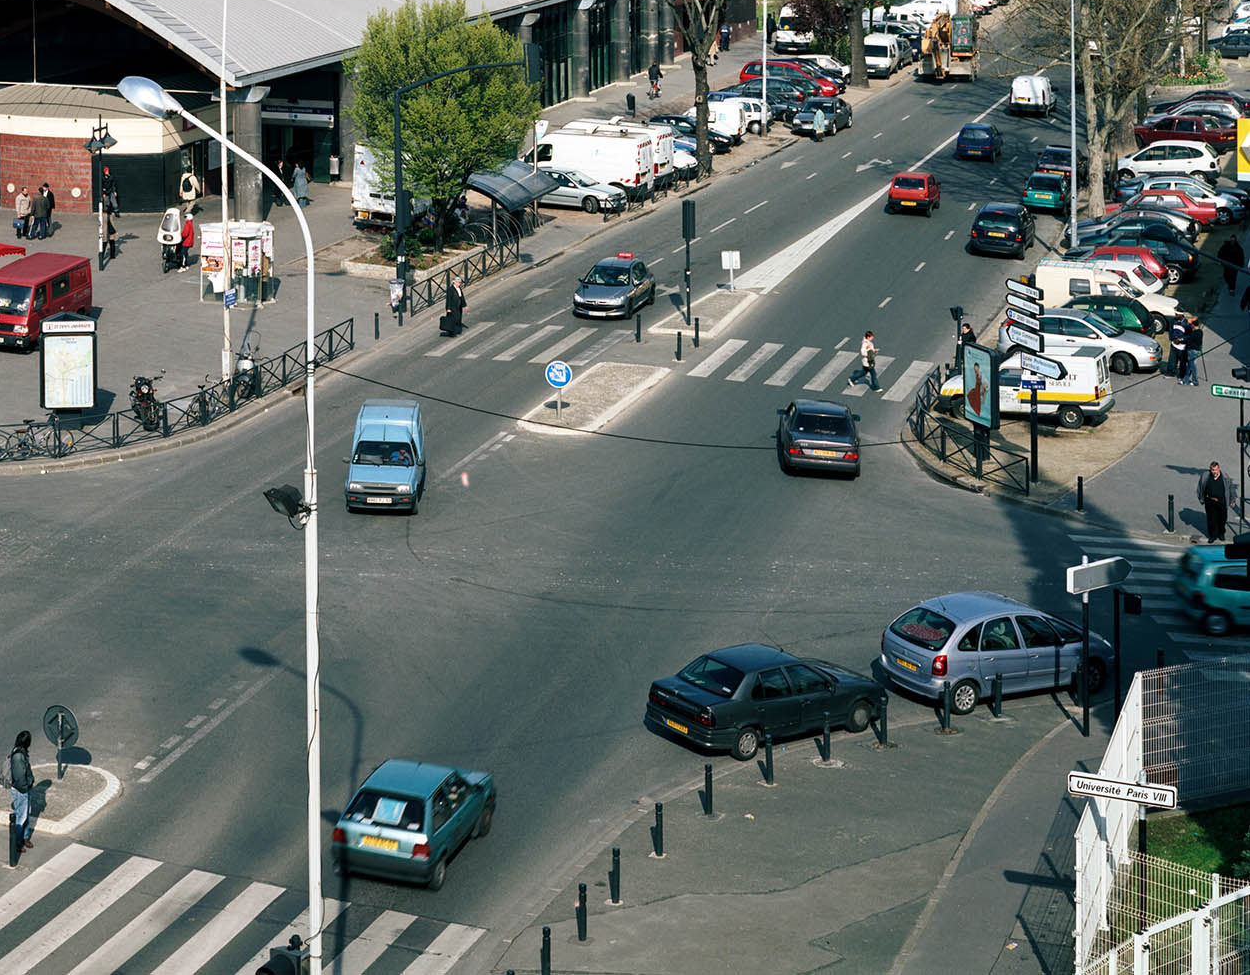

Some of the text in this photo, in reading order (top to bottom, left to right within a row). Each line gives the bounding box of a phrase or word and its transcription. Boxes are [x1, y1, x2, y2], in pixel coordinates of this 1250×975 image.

[1076, 780, 1167, 802] Université Paris VIII
